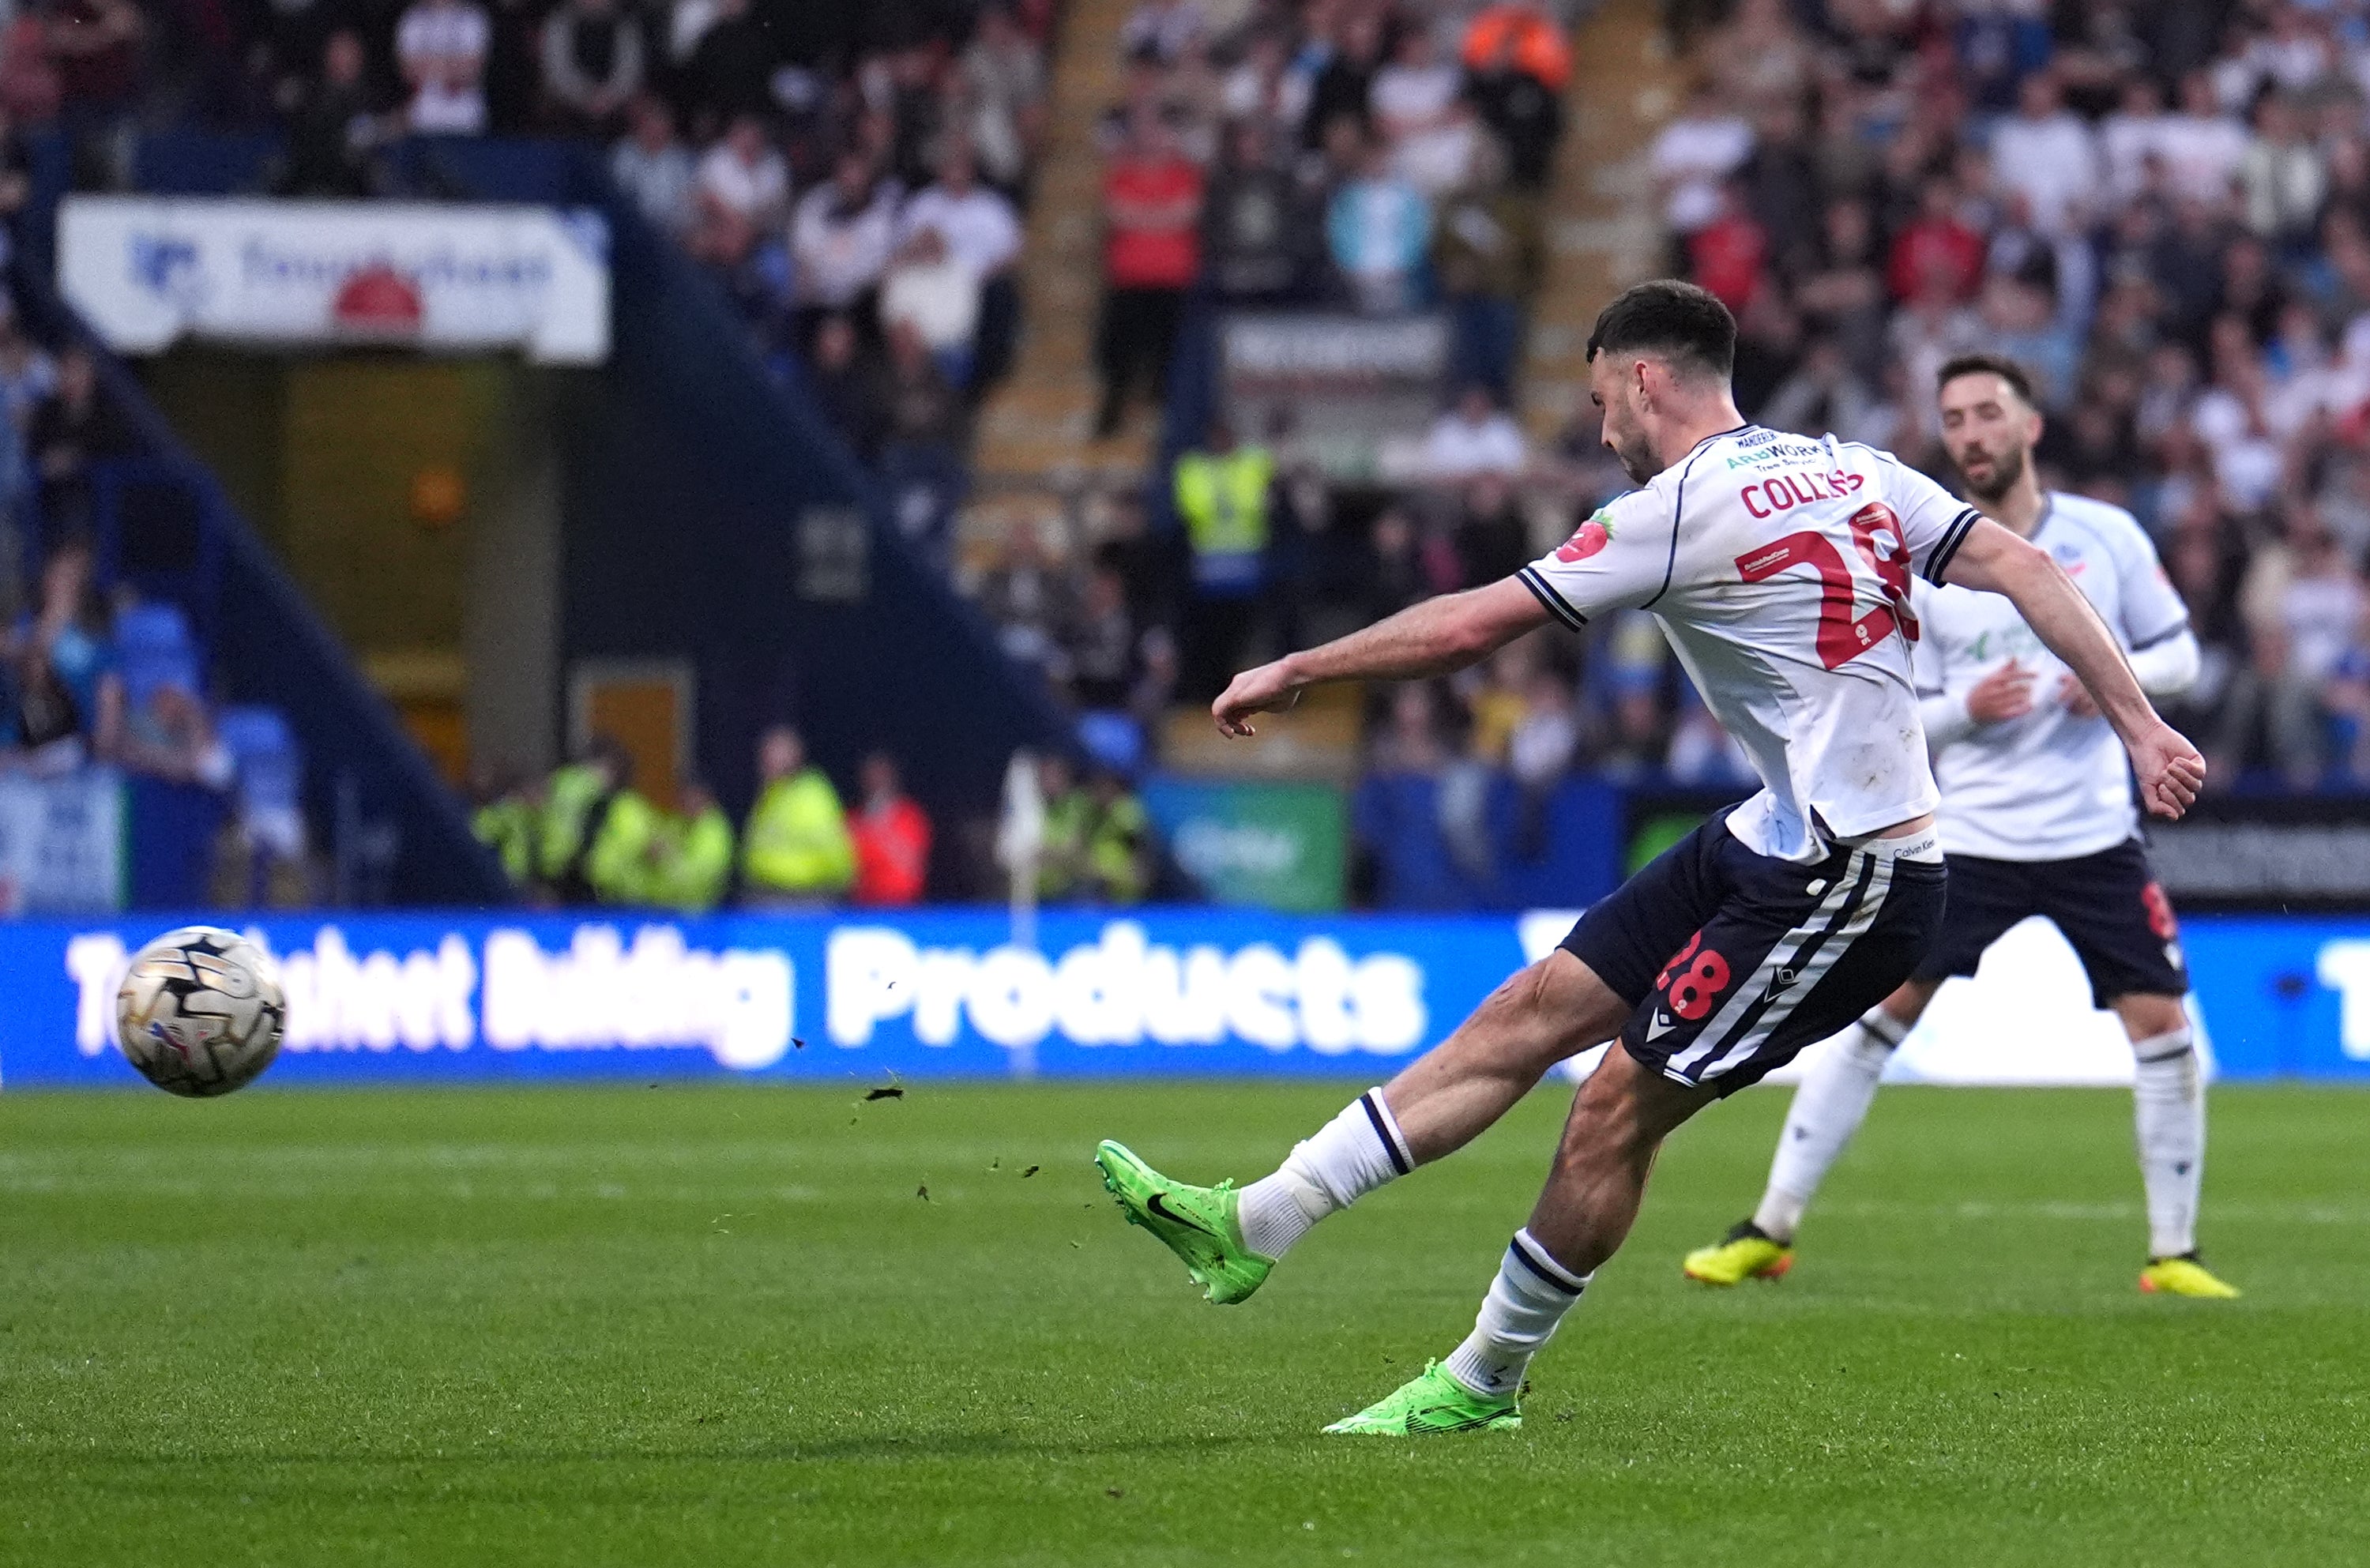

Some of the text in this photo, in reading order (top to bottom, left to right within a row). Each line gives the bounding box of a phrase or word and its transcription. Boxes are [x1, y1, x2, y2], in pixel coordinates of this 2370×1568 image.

[1736, 431, 1779, 449] WANDERER
[1733, 499, 1920, 671] 28
[1893, 844, 1922, 860] Calvin
[63, 924, 476, 1056] Tsheet
[825, 919, 1428, 1056] Products
